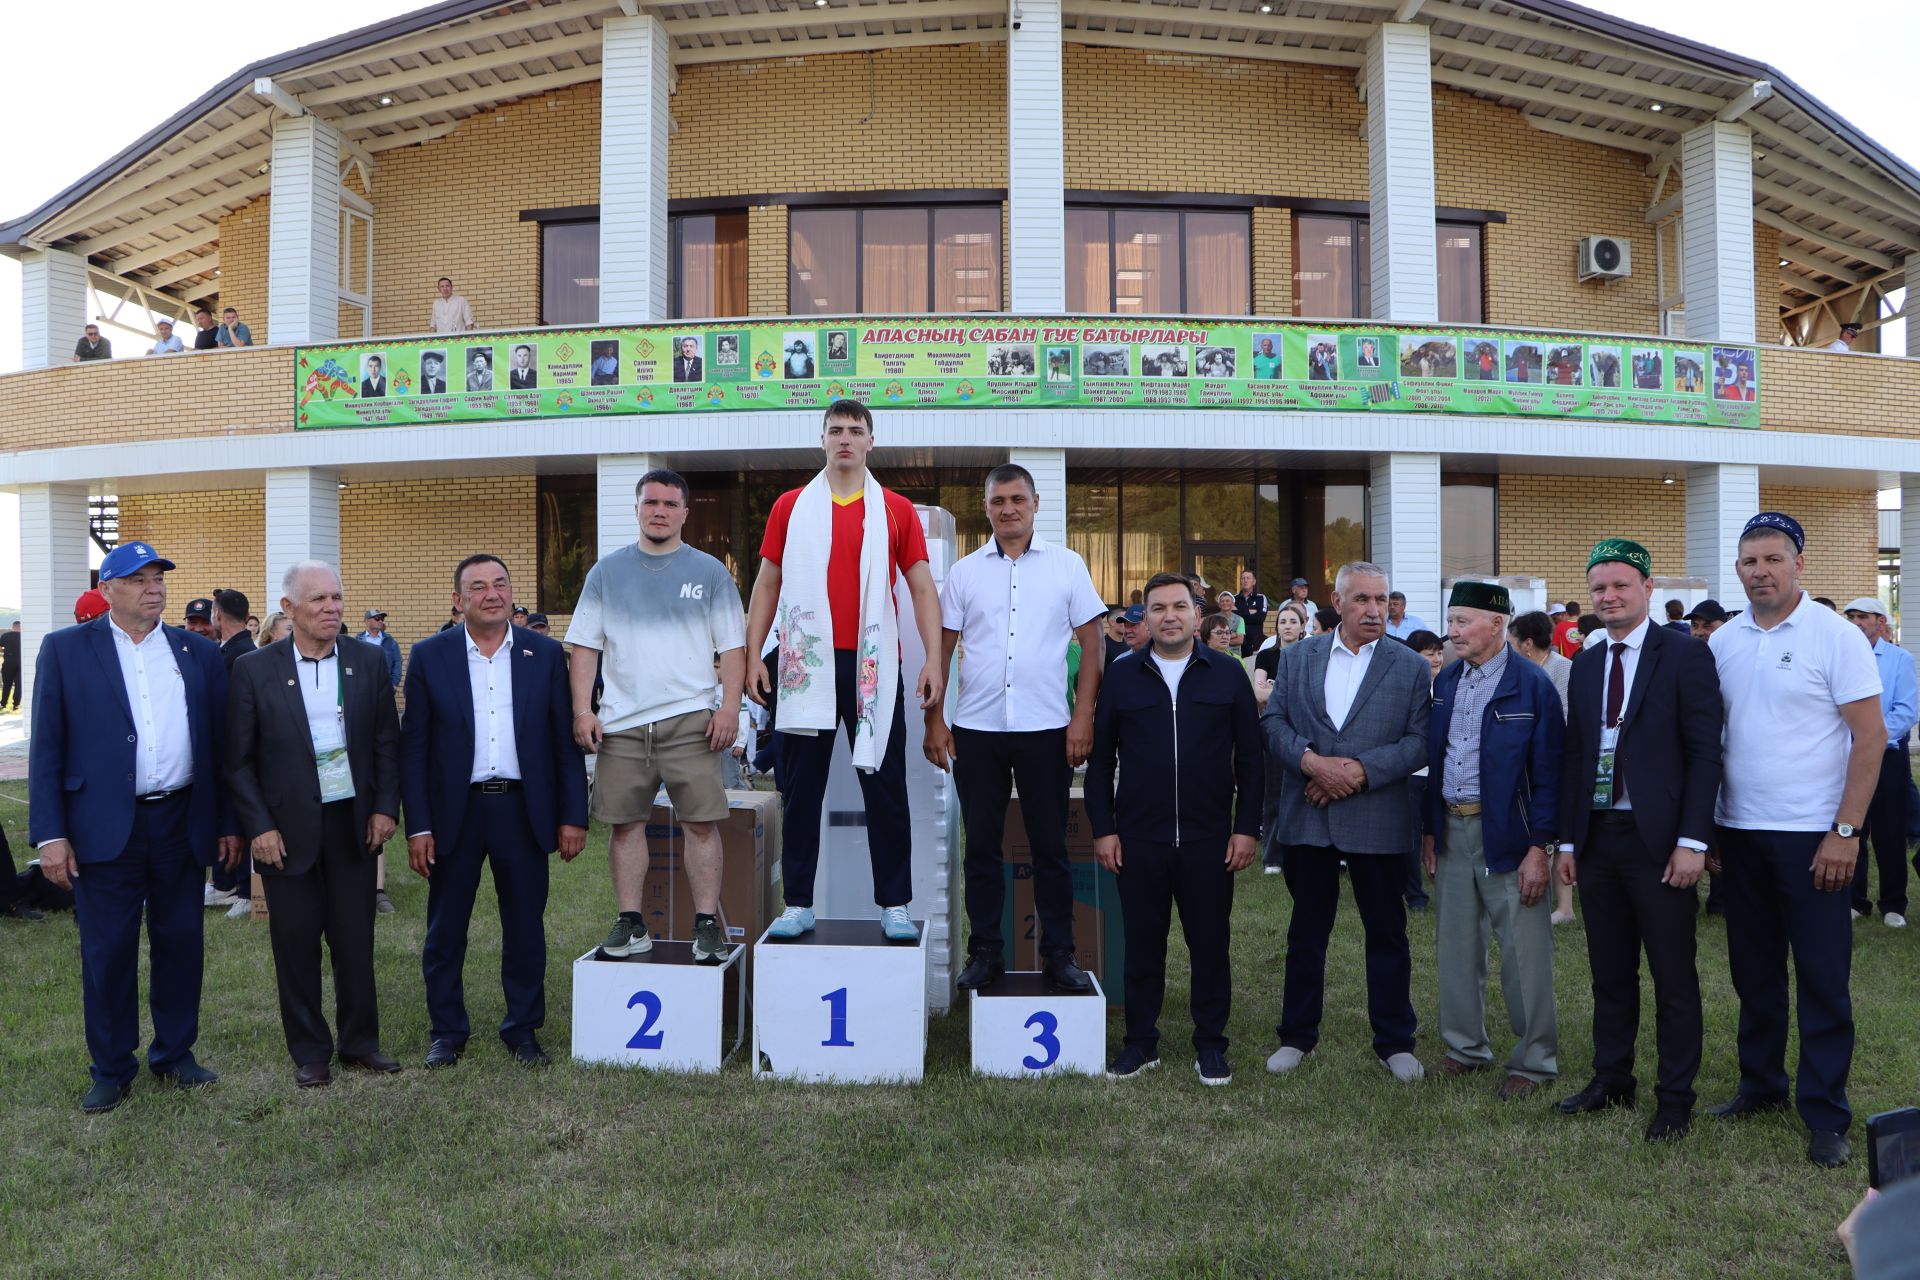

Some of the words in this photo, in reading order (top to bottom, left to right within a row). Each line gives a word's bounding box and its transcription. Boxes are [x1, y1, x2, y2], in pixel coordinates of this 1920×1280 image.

[862, 328, 965, 344] АПАСНЫҢ
[968, 328, 1038, 343] САБАН
[1042, 328, 1080, 343] ТУЕ
[1082, 328, 1208, 344] БАТЫРЛАРЫ
[680, 582, 703, 600] NG
[625, 990, 664, 1050] 2
[820, 987, 855, 1047] 1
[1022, 1010, 1062, 1070] 3
